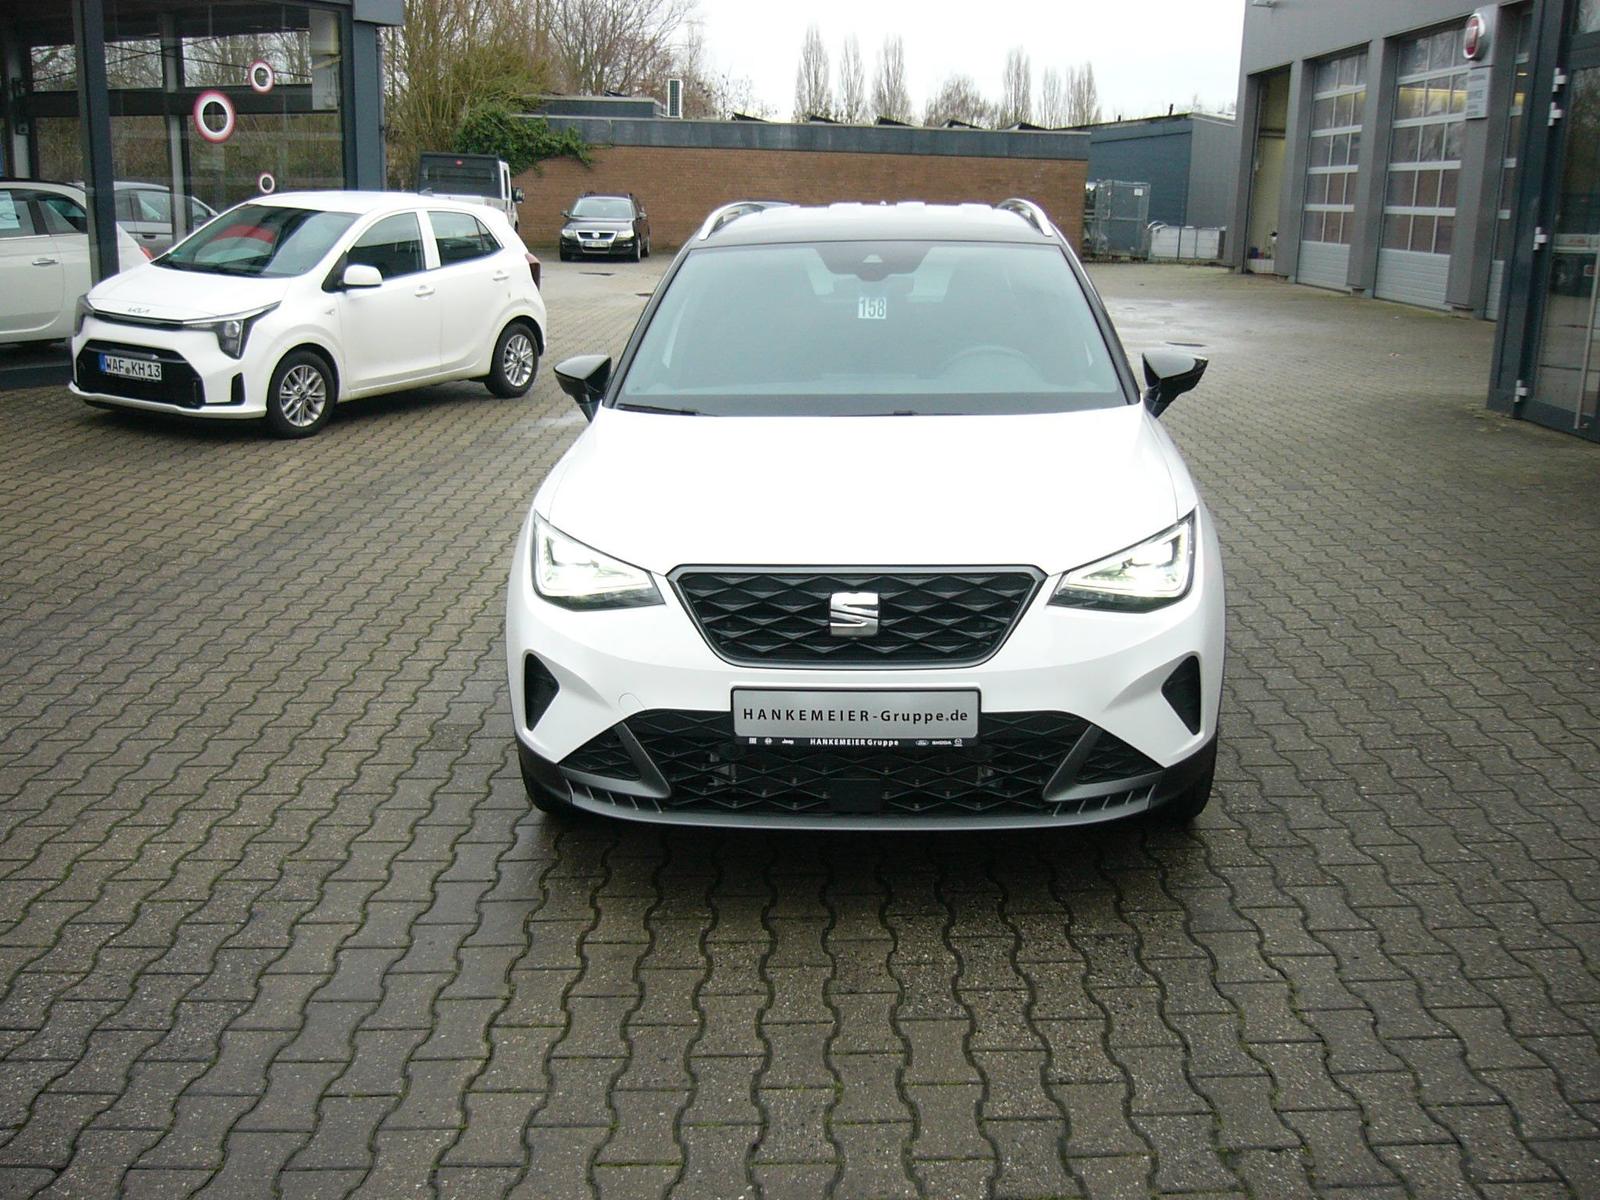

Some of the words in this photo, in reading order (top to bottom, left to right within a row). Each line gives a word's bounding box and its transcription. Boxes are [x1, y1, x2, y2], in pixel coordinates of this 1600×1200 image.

[859, 297, 885, 318] 158
[105, 357, 125, 373] WAF
[131, 361, 146, 377] KH
[147, 363, 161, 379] 13
[743, 708, 968, 725] HANKEMEIER-Gruppe.de
[810, 738, 866, 746] HANKEMEIER
[867, 738, 899, 747] Gruppe
